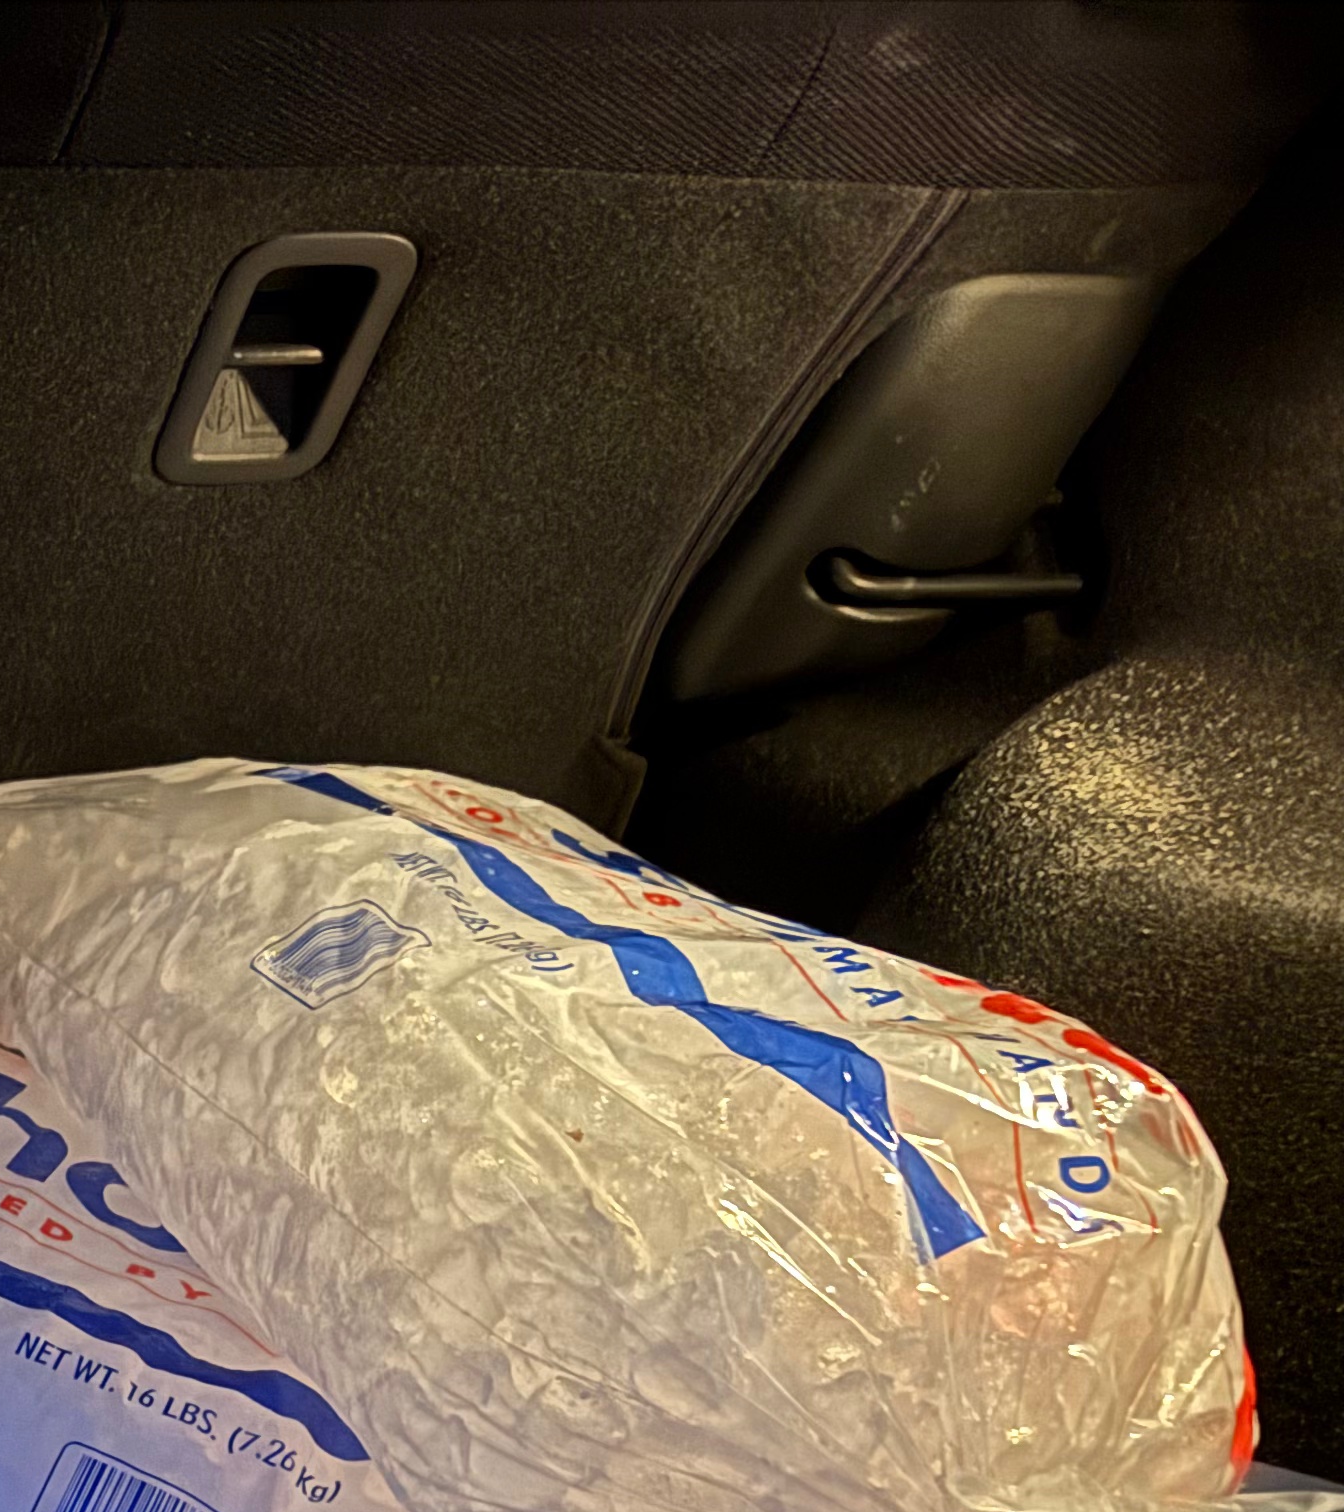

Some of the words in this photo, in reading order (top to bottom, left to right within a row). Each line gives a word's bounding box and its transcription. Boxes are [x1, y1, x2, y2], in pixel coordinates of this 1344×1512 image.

[14, 1331, 72, 1371] NET
[72, 1353, 119, 1394] WT.
[126, 1381, 155, 1409] 16
[162, 1397, 218, 1441] LBS.
[227, 1426, 297, 1472] (7.26
[295, 1466, 342, 1504] Kg)
